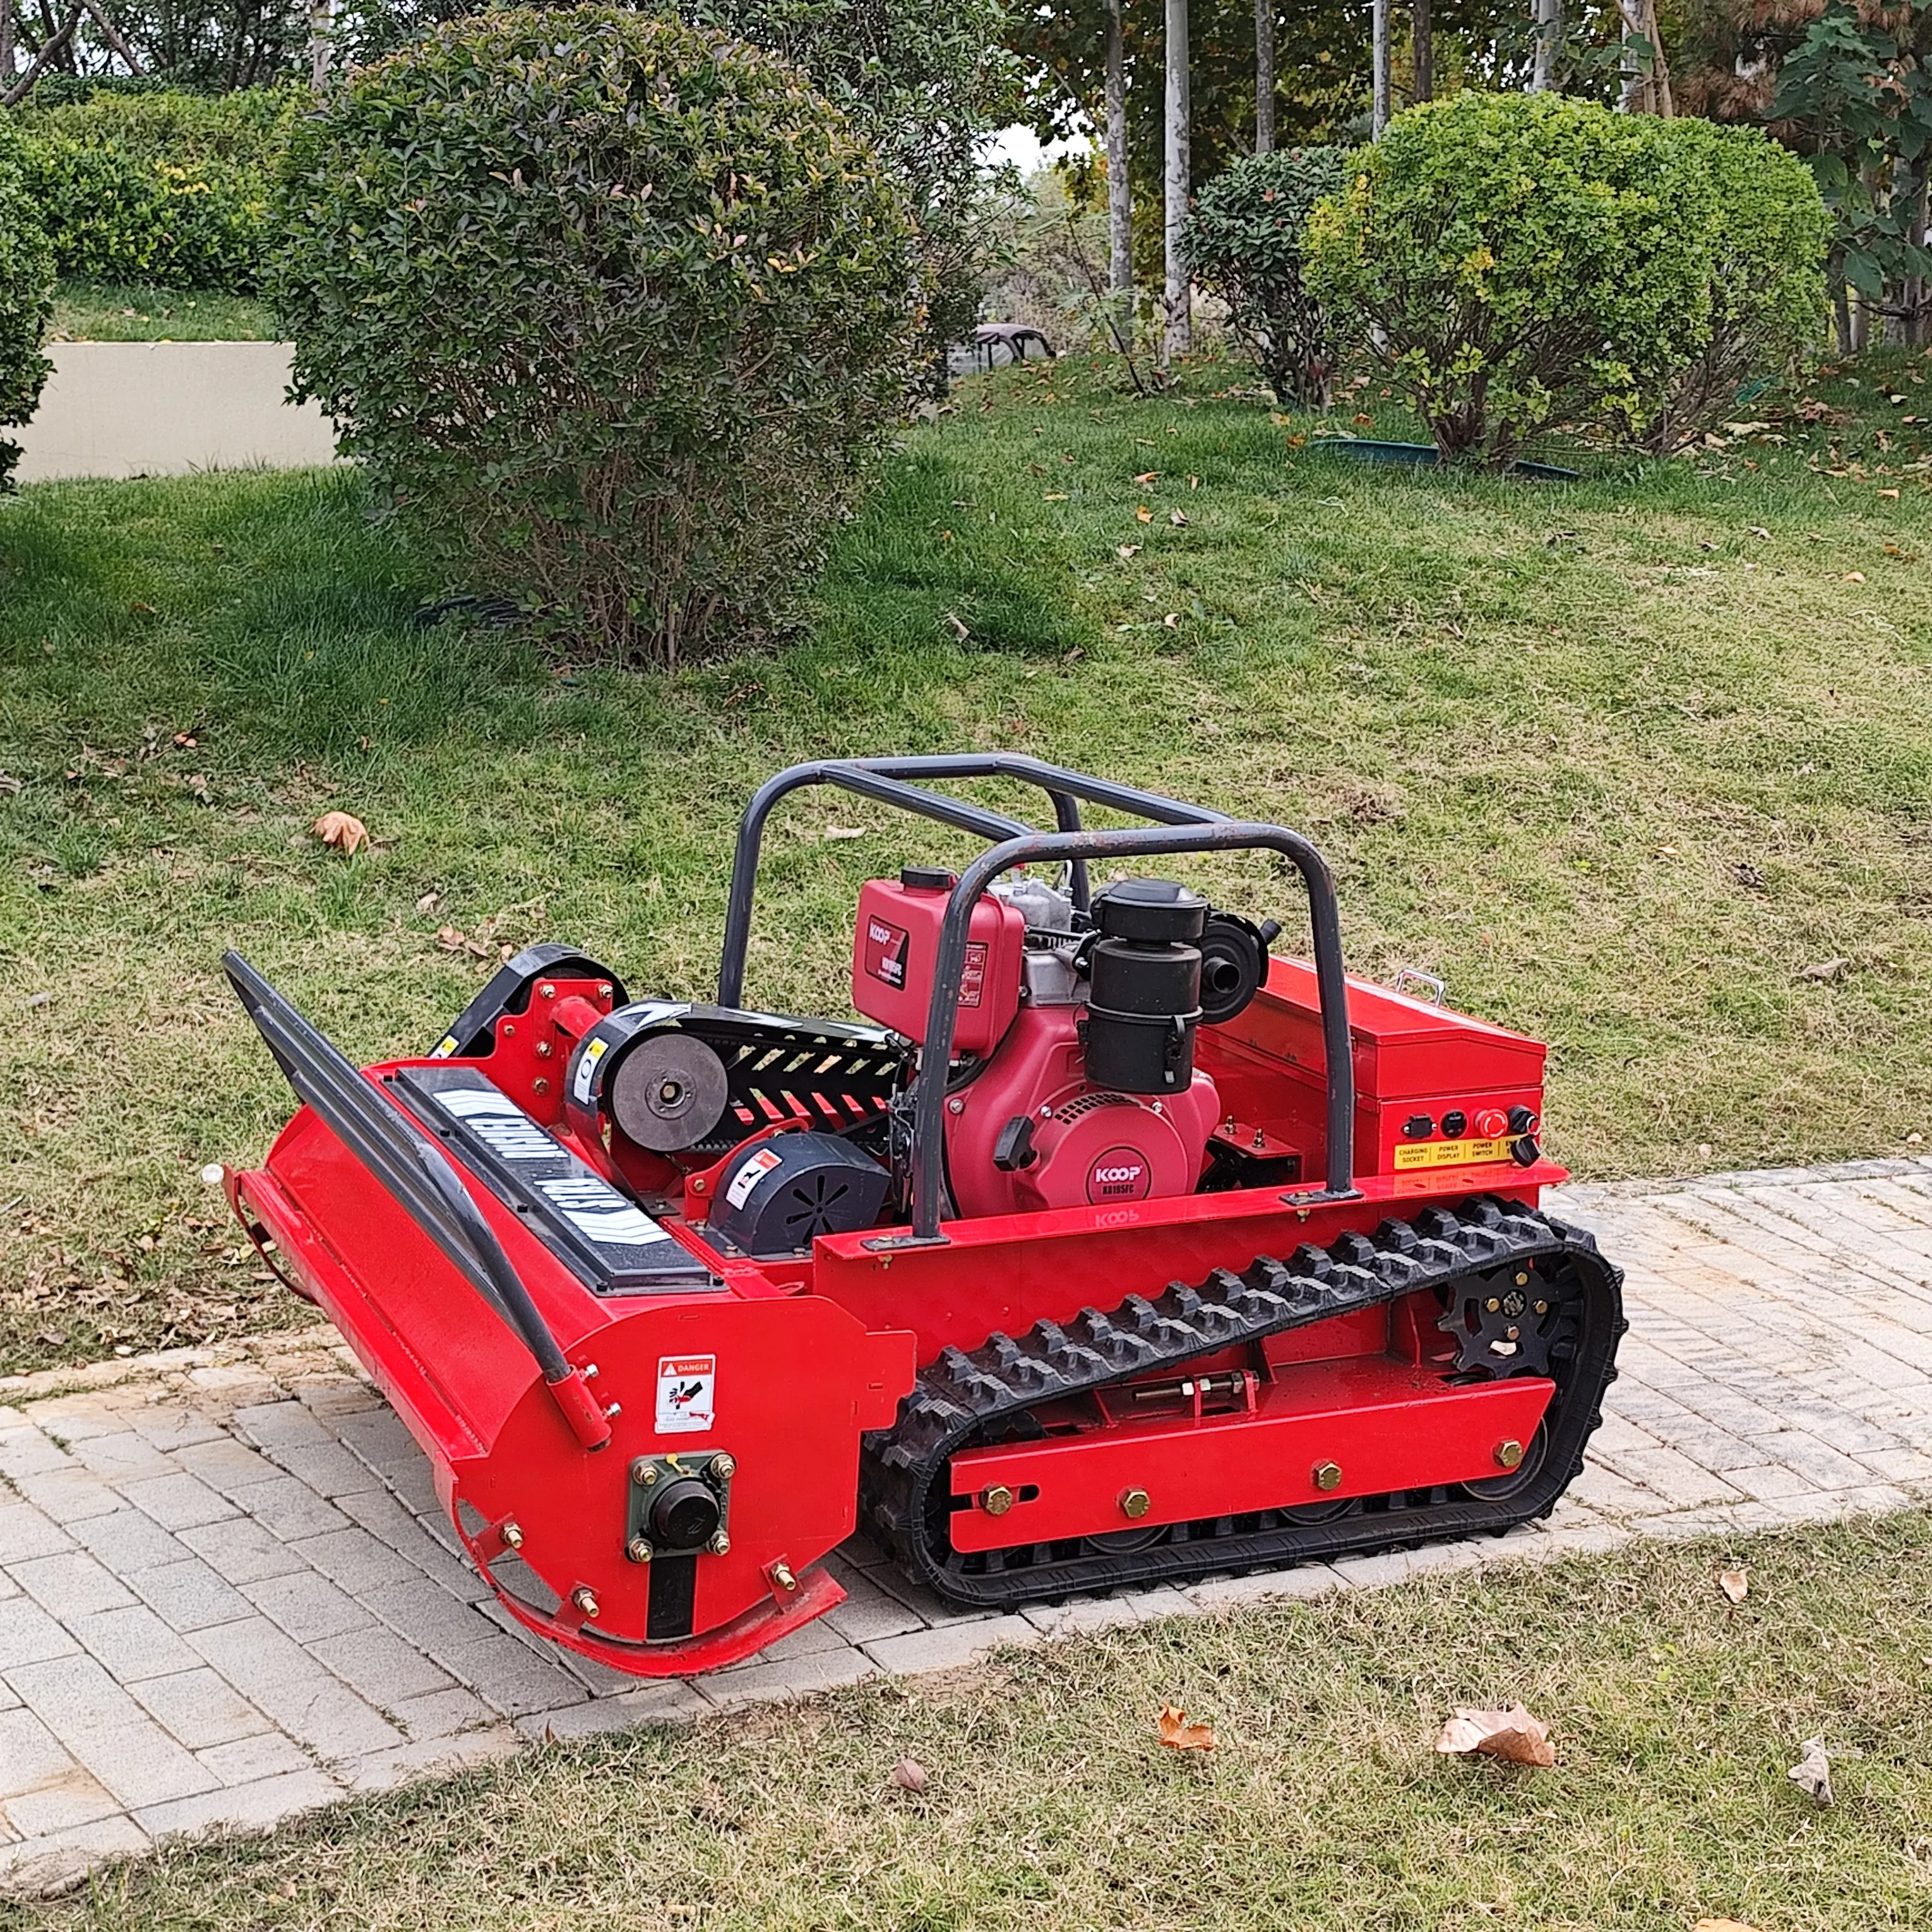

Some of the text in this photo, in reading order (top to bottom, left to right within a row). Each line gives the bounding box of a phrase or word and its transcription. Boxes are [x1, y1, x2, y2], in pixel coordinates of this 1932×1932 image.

[869, 922, 890, 945] KOOP
[1095, 1166, 1141, 1183] KOOP
[677, 1363, 709, 1372] DANGER
